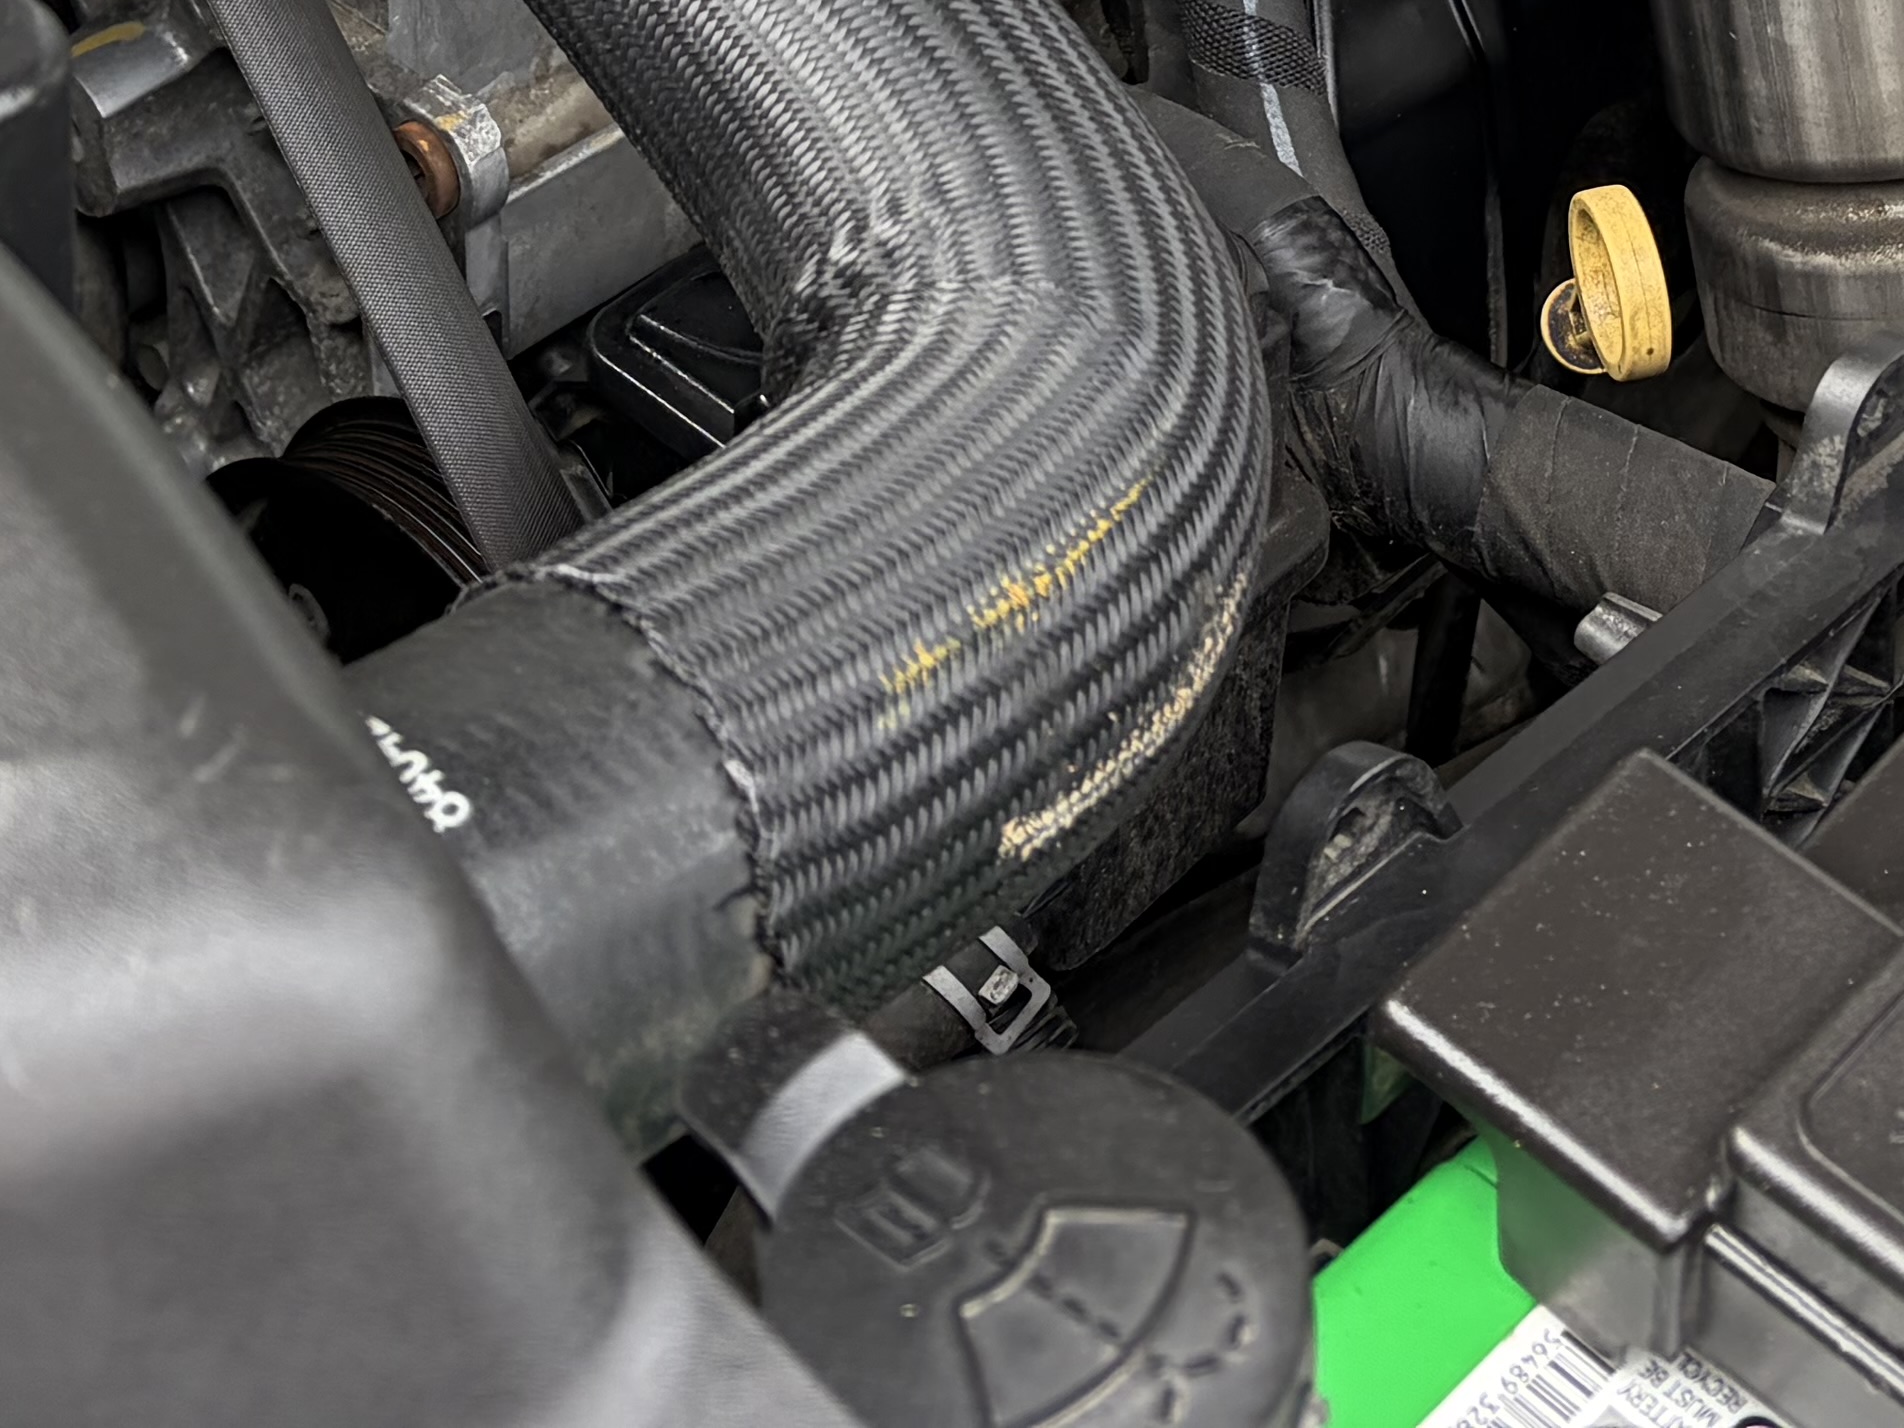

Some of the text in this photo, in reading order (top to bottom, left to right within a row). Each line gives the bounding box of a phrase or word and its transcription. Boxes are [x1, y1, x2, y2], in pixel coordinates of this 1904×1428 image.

[1500, 1328, 1561, 1395] 56489
[1638, 1358, 1722, 1428] MUST BE
